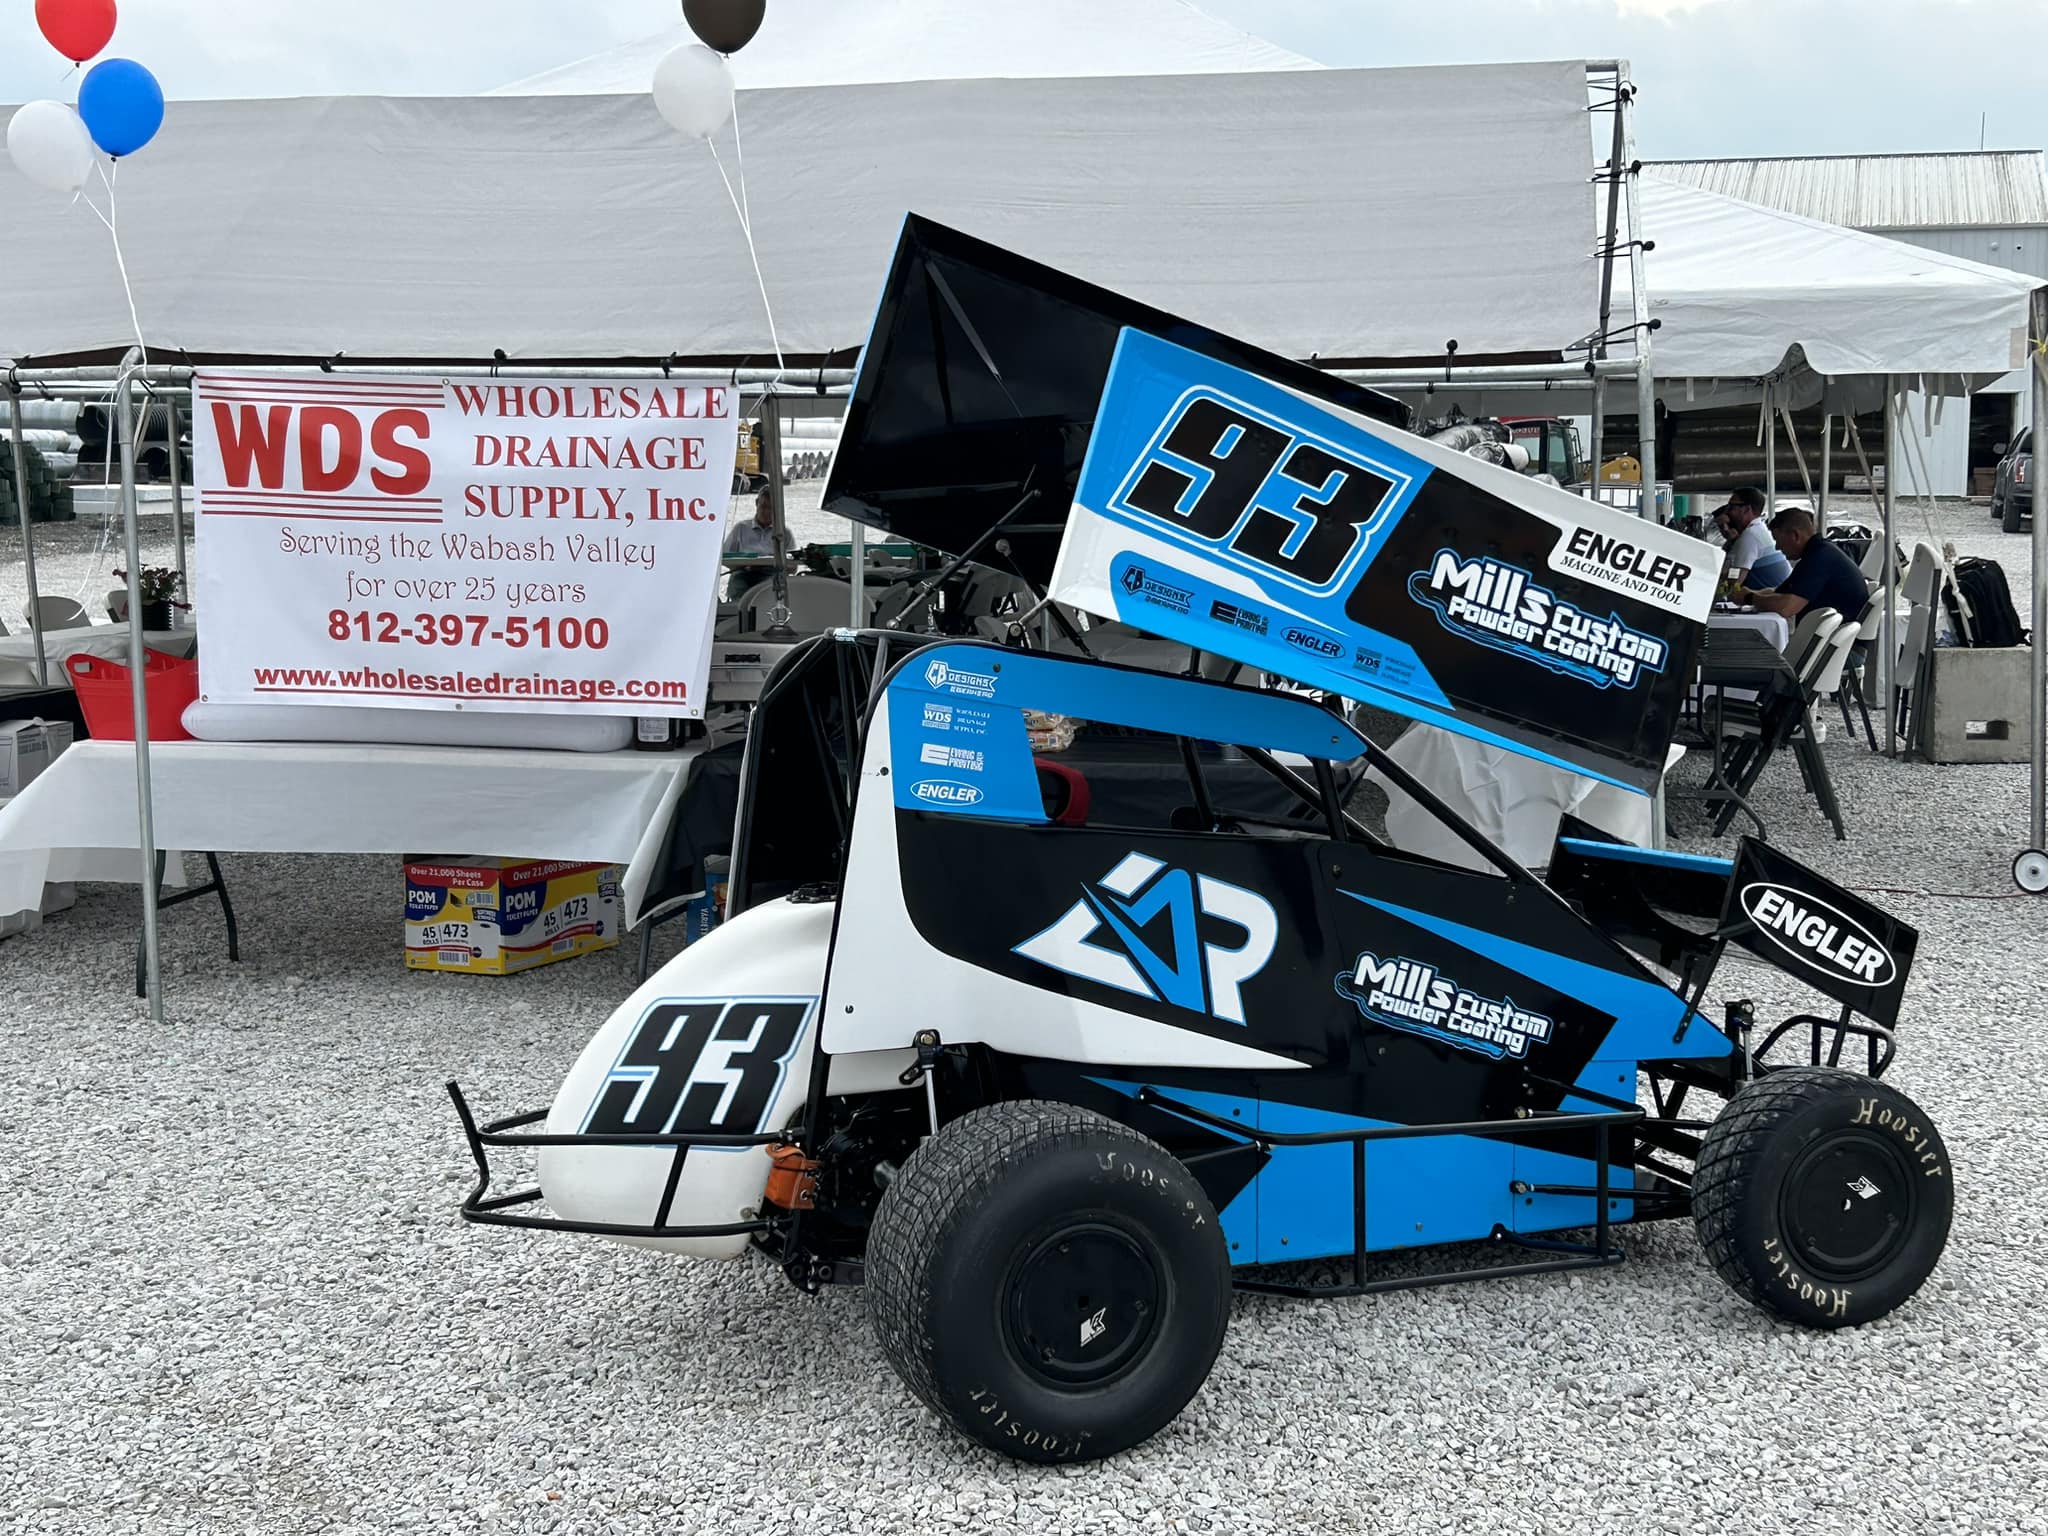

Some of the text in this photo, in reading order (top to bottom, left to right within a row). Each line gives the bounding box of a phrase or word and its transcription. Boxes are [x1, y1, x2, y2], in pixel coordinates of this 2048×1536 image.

[450, 385, 729, 419] WHOLESALE
[211, 402, 431, 495] WDS
[472, 435, 707, 470] DRAINAGE
[464, 484, 716, 528] SUPPLY, Inc.
[1120, 396, 1398, 586] 93
[280, 526, 655, 570] Serving the Wabash Valley
[1566, 526, 1692, 592] ENGLER
[346, 570, 586, 608] for over 25 years
[1559, 555, 1683, 606] MACHINE AND TOOL
[1431, 553, 1662, 665] Mills Custom
[328, 609, 609, 650] 812-397-5100
[1286, 629, 1340, 656] ENGLER
[1449, 595, 1635, 683] Powder Coating
[948, 672, 989, 687] DESIGNS
[1356, 653, 1381, 668] WDS
[254, 667, 687, 701] www.wholesaledrainage.com
[924, 710, 952, 722] WDS
[917, 784, 977, 801] ENGLER
[411, 867, 427, 875] Over
[513, 870, 531, 881] Over
[408, 890, 436, 904] POM
[505, 890, 536, 912] POM
[564, 897, 588, 919] 473
[422, 924, 469, 938] 45 473
[544, 911, 556, 928] 45
[1751, 889, 1885, 982] ENGLER
[1354, 955, 1549, 1038] Mills Custom
[1368, 989, 1526, 1054] Powder Coating
[584, 1002, 810, 1136] 93
[1851, 1098, 1943, 1177] Hoosier
[1763, 1238, 1852, 1318] Hoosier
